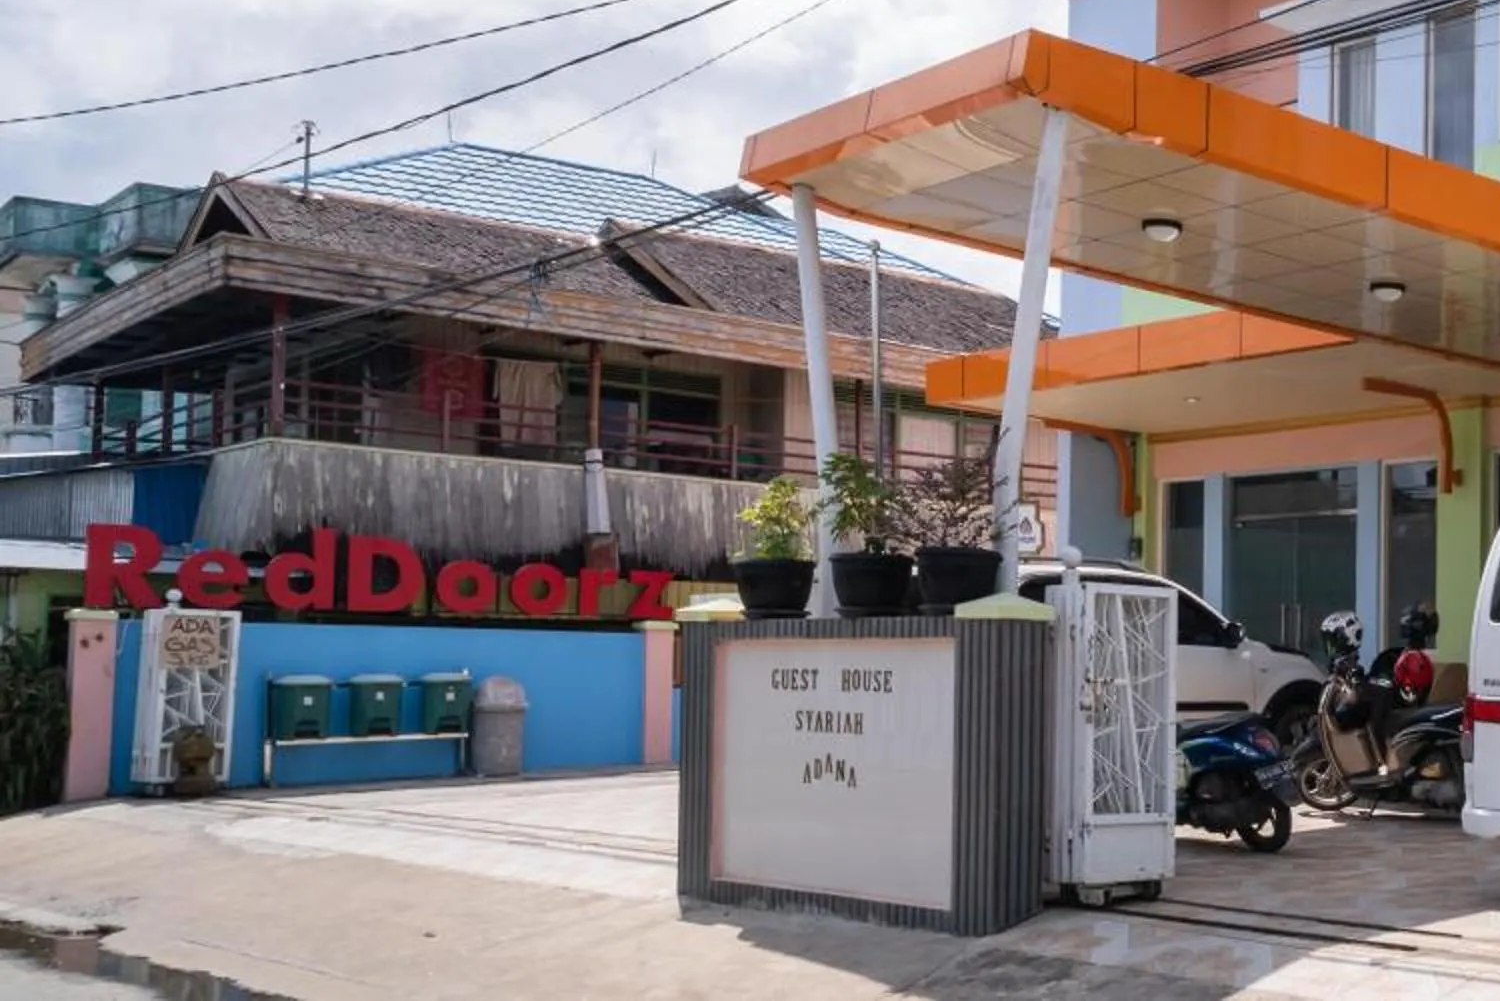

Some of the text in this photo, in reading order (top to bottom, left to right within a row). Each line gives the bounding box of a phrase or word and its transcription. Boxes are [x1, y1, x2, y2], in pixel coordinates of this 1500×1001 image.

[83, 523, 674, 619] RedDoorz
[170, 618, 215, 634] ADA
[164, 636, 216, 654] GAS
[771, 668, 893, 693] GUEST HOUSE
[795, 710, 864, 735] SYARIAH
[802, 752, 857, 788] ADANA
